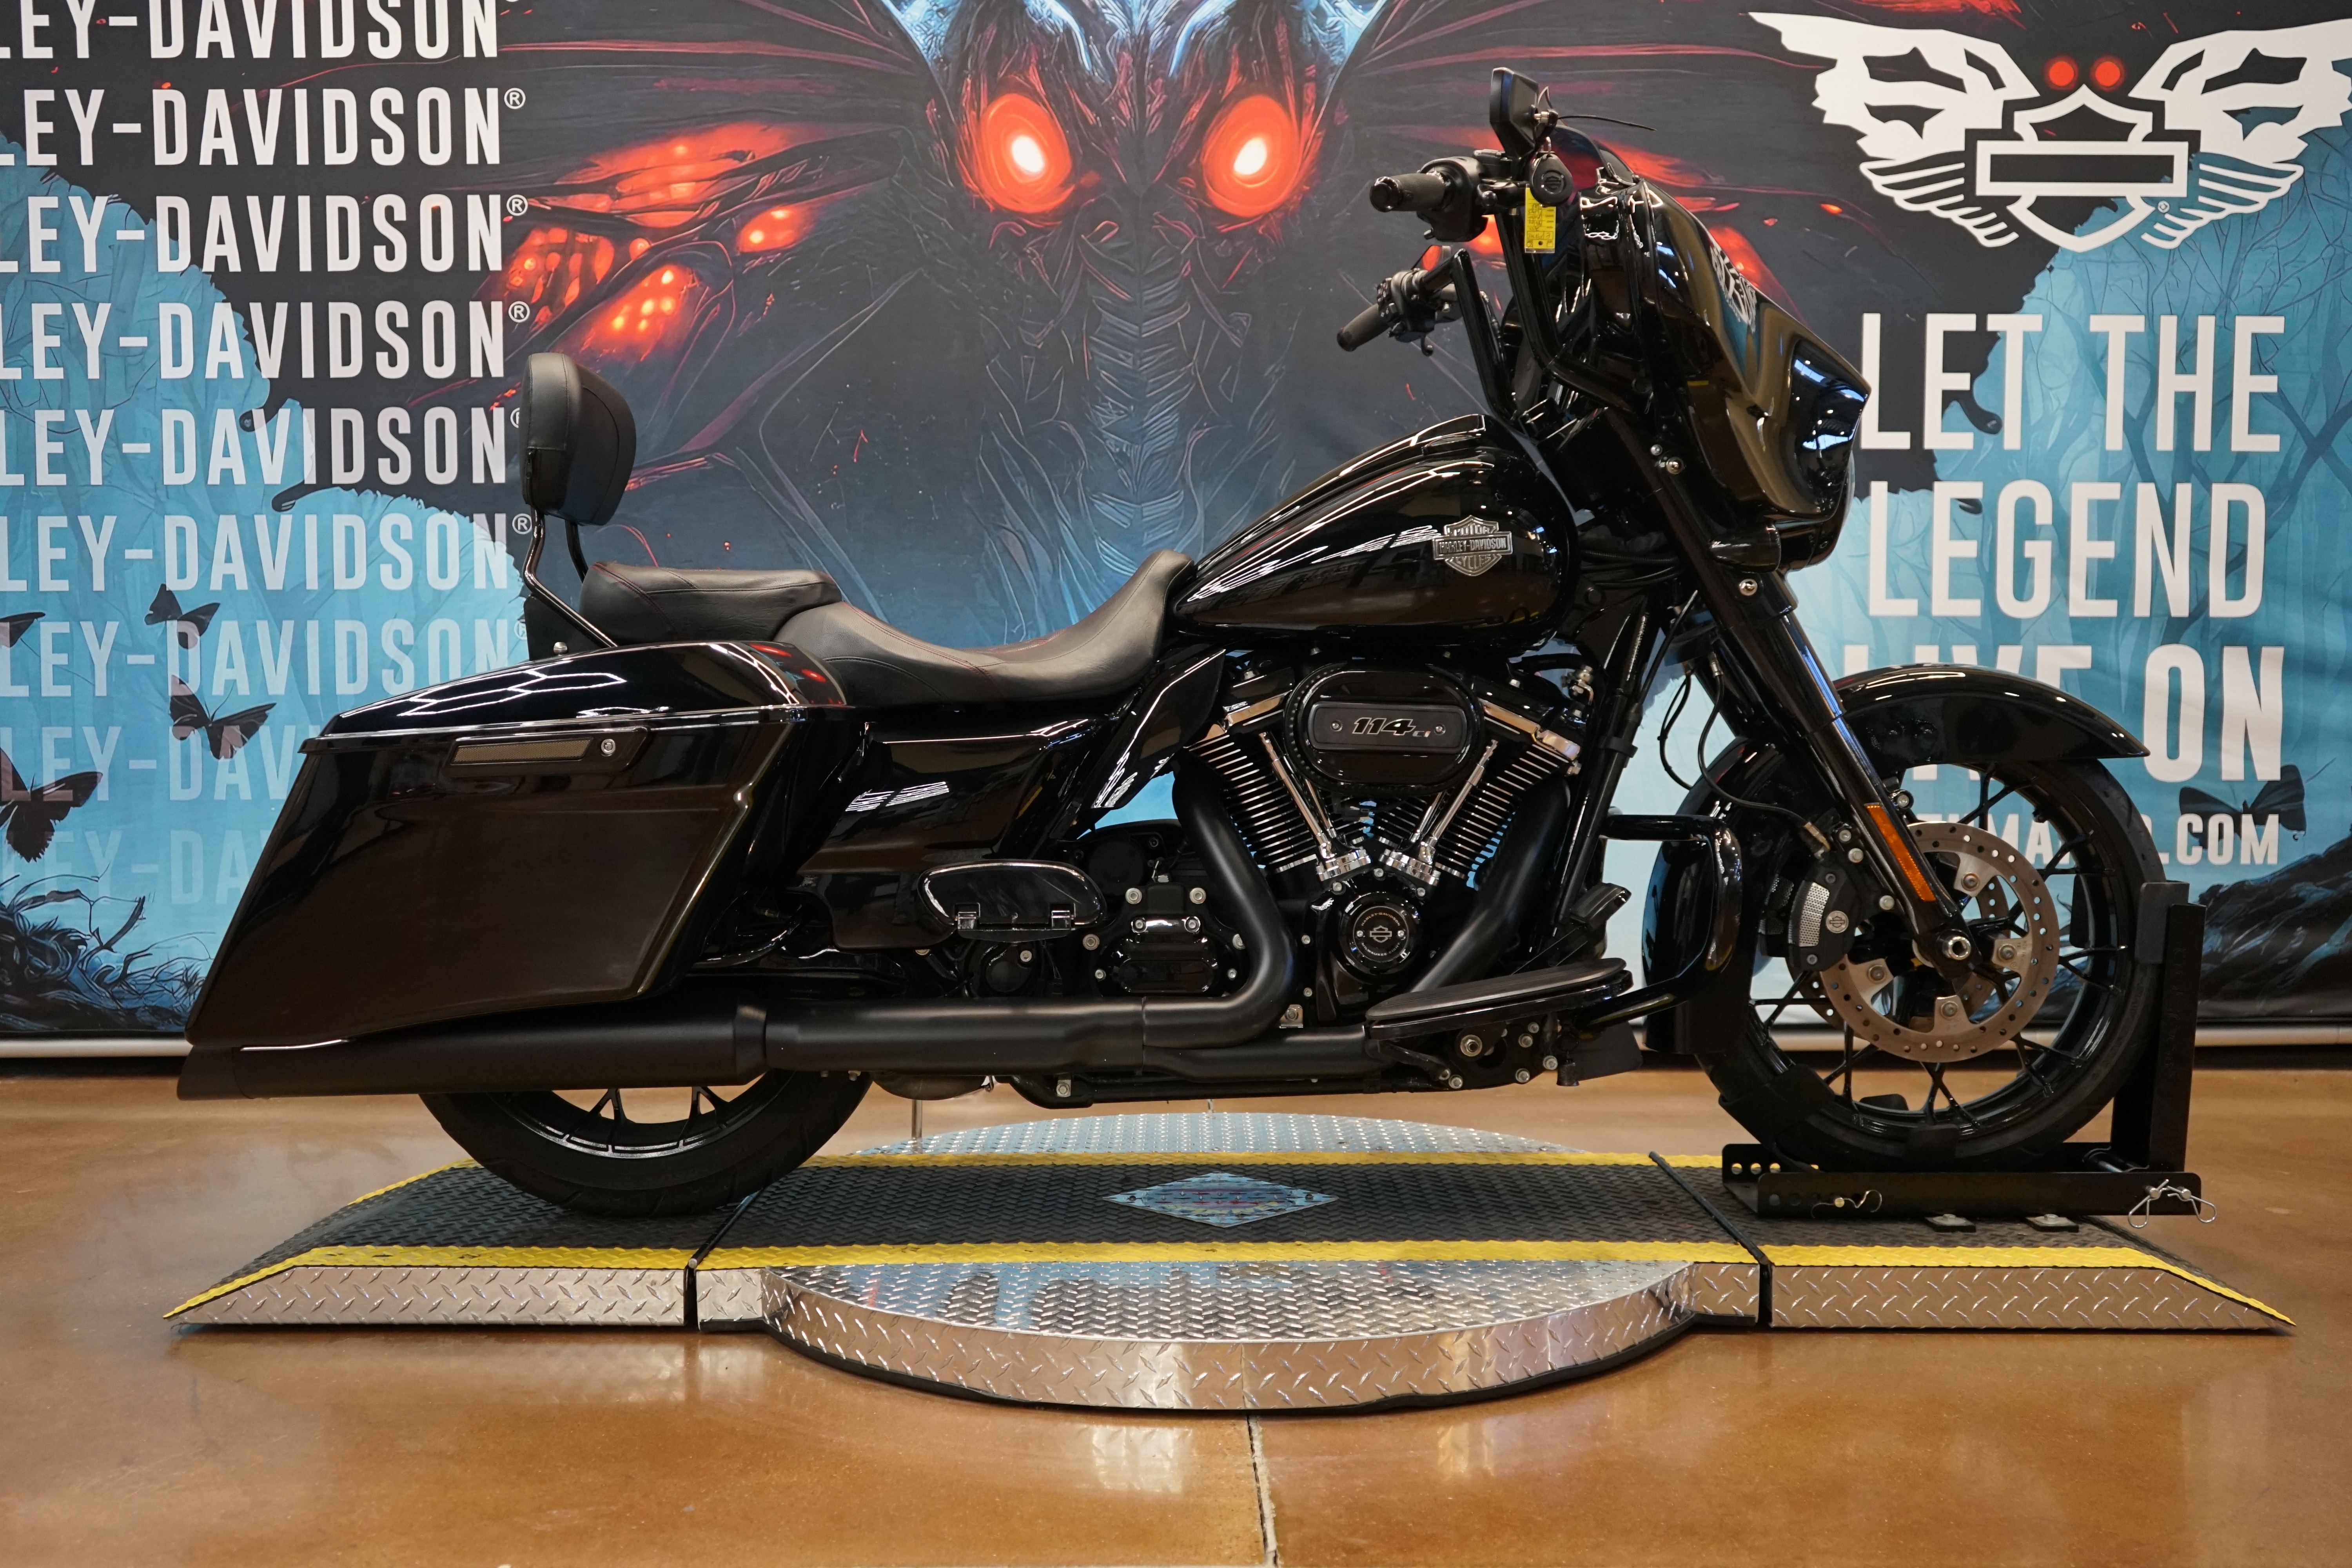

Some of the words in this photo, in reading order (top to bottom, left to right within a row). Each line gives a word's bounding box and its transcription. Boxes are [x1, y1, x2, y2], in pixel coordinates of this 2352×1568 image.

[0, 0, 498, 58] EY-DAVIDSON
[1860, 313, 2042, 450] LET
[2090, 315, 2285, 452] THE
[1453, 523, 1491, 536] MOTOR
[1439, 537, 1507, 554] HARLEY-DAVIDSON
[1868, 480, 2266, 619] LEGEND
[1456, 554, 1491, 570] CYCLES
[2141, 643, 2285, 782] ON
[1352, 717, 1416, 736] 114
[0, 724, 320, 802] LEY-DAV
[1361, 911, 1401, 926] HARLEY-DAVIDSON
[1361, 942, 1401, 956] MILWAUKEE-EIGHT
